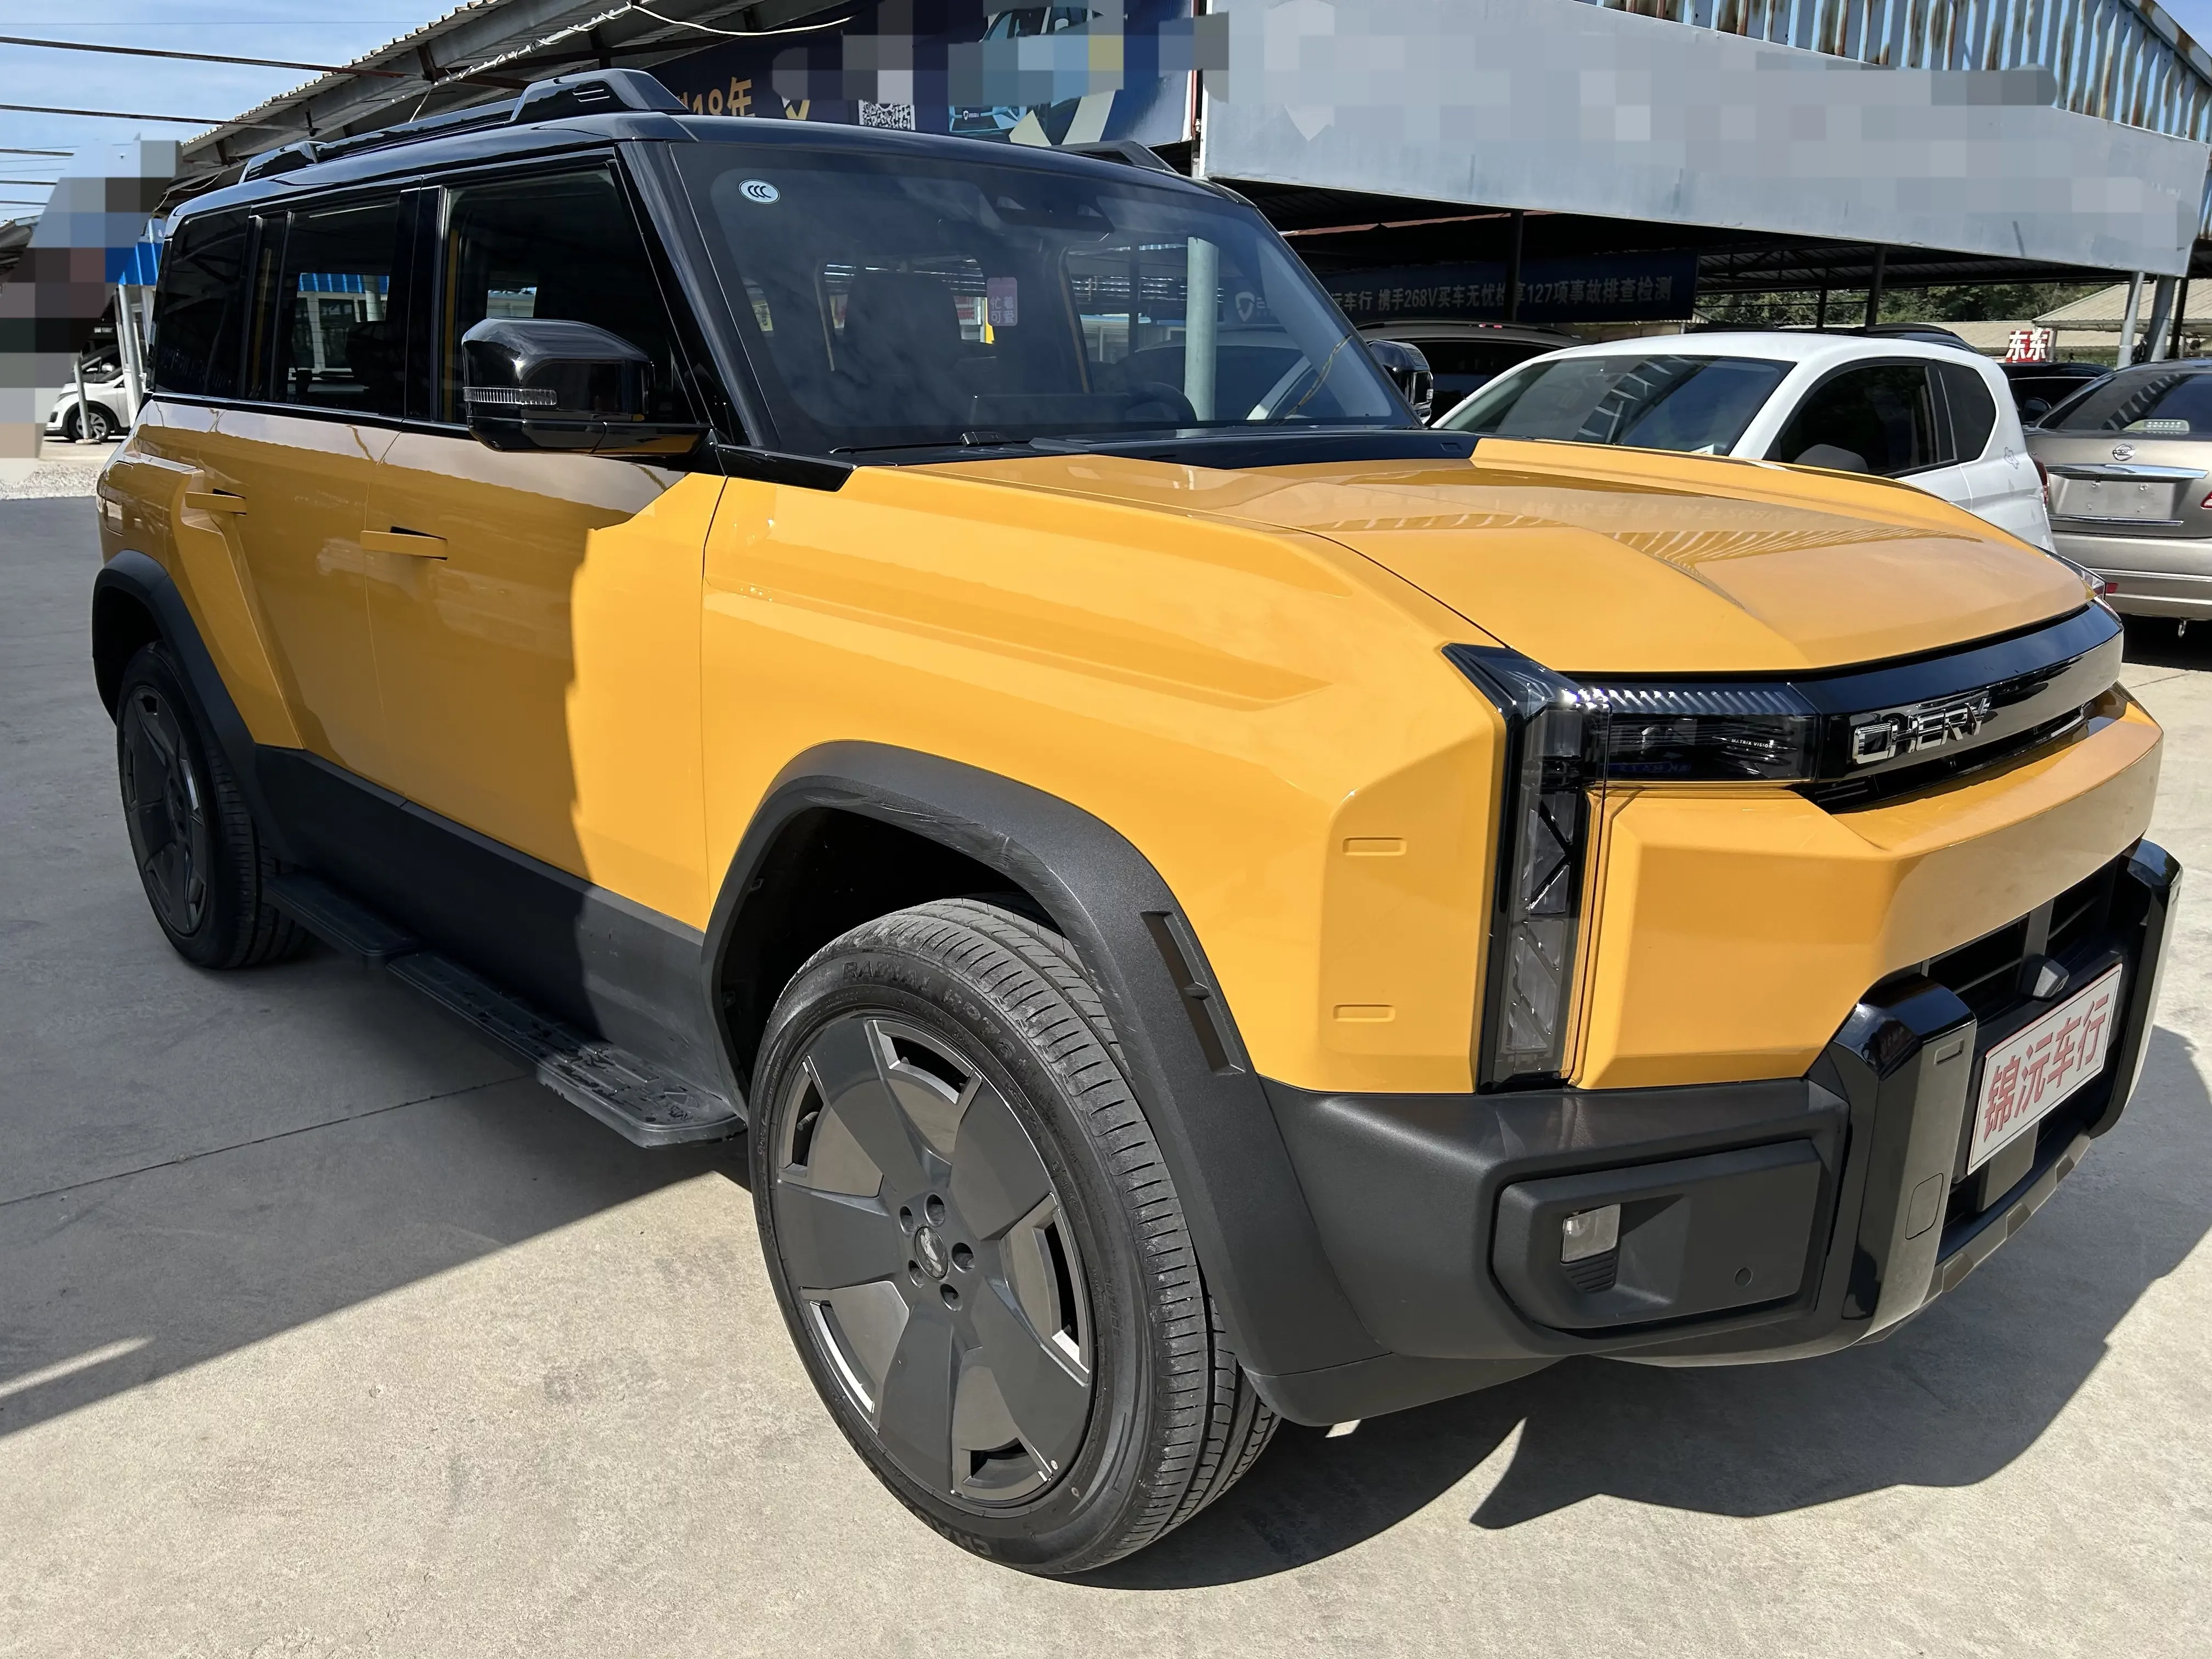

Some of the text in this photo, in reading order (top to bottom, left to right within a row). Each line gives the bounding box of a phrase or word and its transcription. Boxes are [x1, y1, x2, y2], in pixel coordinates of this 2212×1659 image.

[990, 310, 1014, 324] 可爱
[1731, 738, 1753, 746] MATRIX
[1852, 697, 1992, 764] CHERY
[1983, 993, 2109, 1143] 锦沅车行
